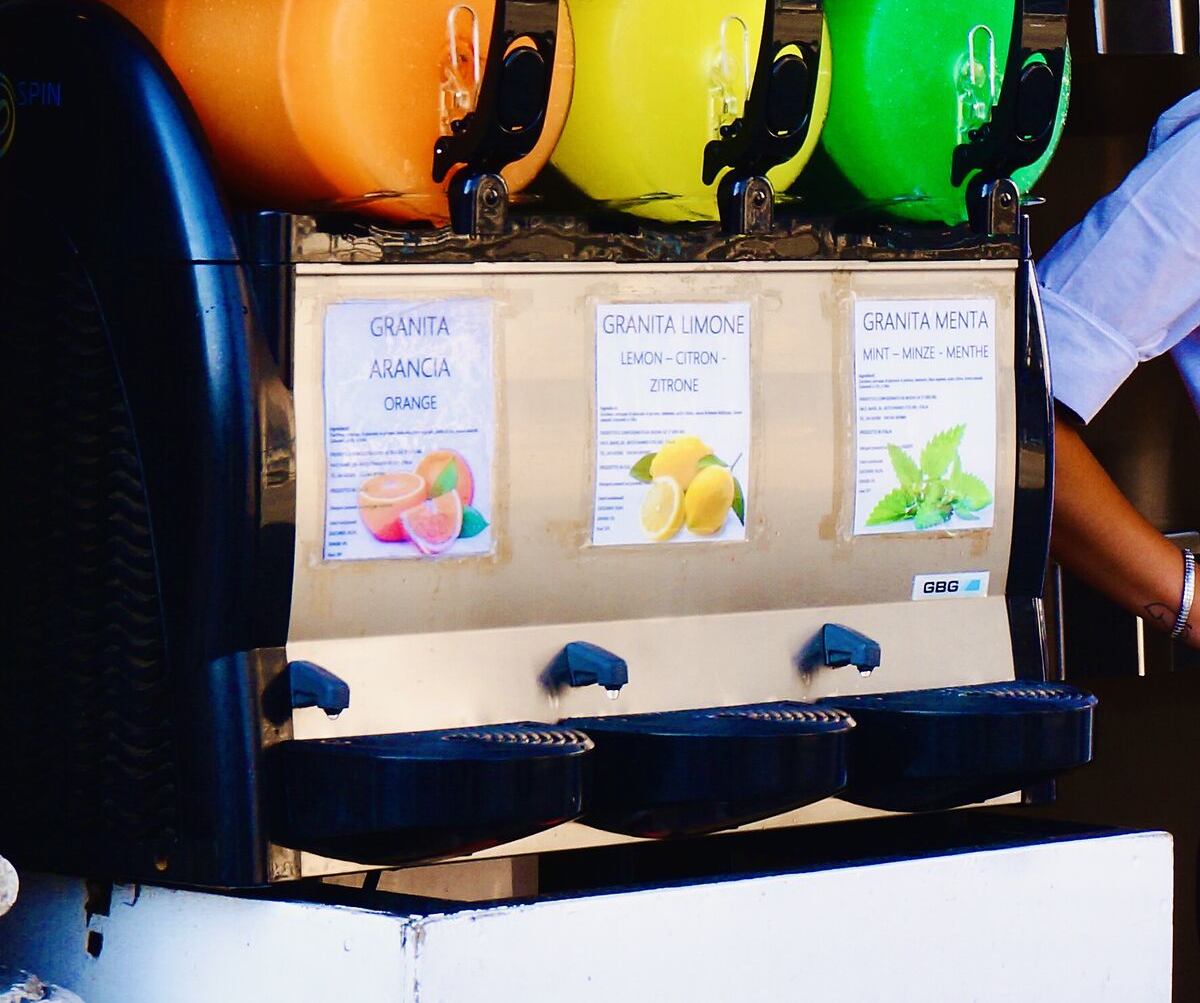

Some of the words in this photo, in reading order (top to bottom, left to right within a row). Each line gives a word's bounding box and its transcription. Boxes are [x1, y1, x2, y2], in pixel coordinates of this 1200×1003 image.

[16, 81, 62, 107] SPIN
[369, 315, 450, 338] GRANITA
[602, 314, 676, 335] GRANITA
[681, 314, 745, 335] LIMONE
[862, 311, 931, 332] GRANITA
[935, 310, 989, 330] MENTA
[620, 351, 663, 366] LEMON
[675, 350, 719, 366] CITRON
[862, 346, 890, 361] MINT
[902, 345, 936, 360] MINZE
[946, 344, 989, 359] MENTHE
[369, 357, 451, 379] ARANCIA
[650, 378, 700, 393] ZITRONE
[383, 395, 438, 411] ORANGE
[923, 580, 960, 594] GBG
